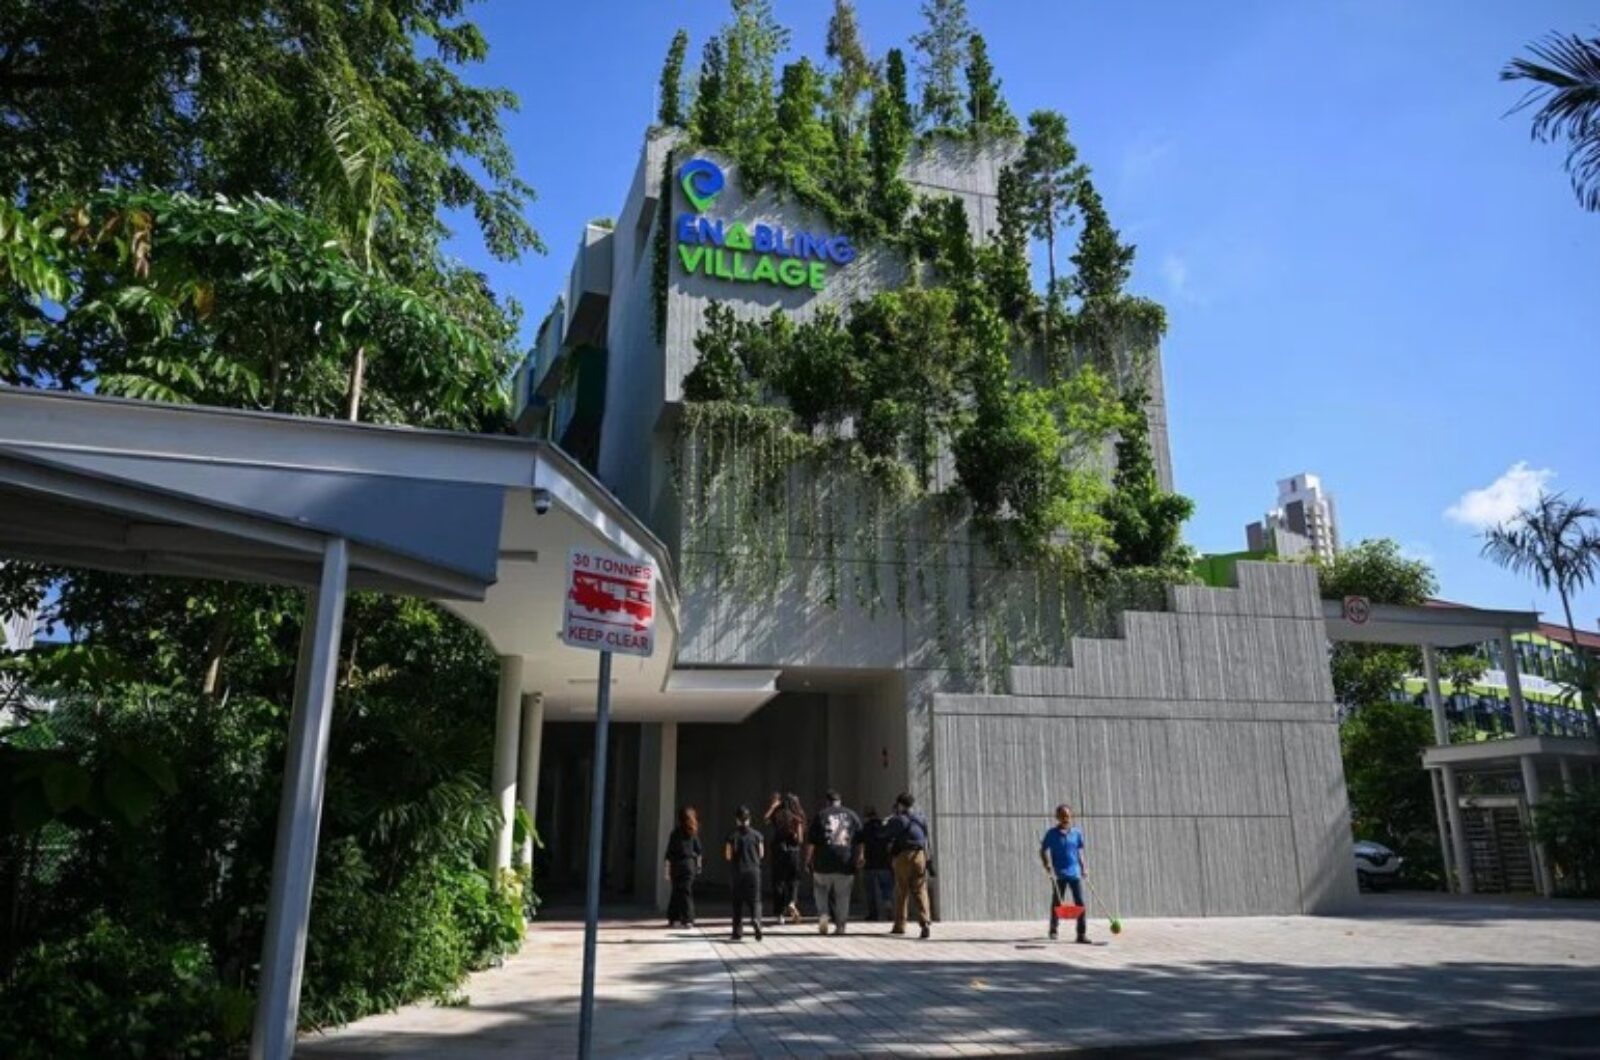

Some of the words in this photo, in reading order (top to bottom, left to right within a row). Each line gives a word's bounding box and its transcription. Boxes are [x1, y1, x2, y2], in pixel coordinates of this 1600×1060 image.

[677, 213, 856, 266] ENABLING
[678, 244, 827, 291] VILLAGE
[573, 553, 590, 568] 30
[595, 556, 652, 580] TONNES
[568, 626, 603, 641] KEEP
[606, 631, 650, 650] CLEAR
